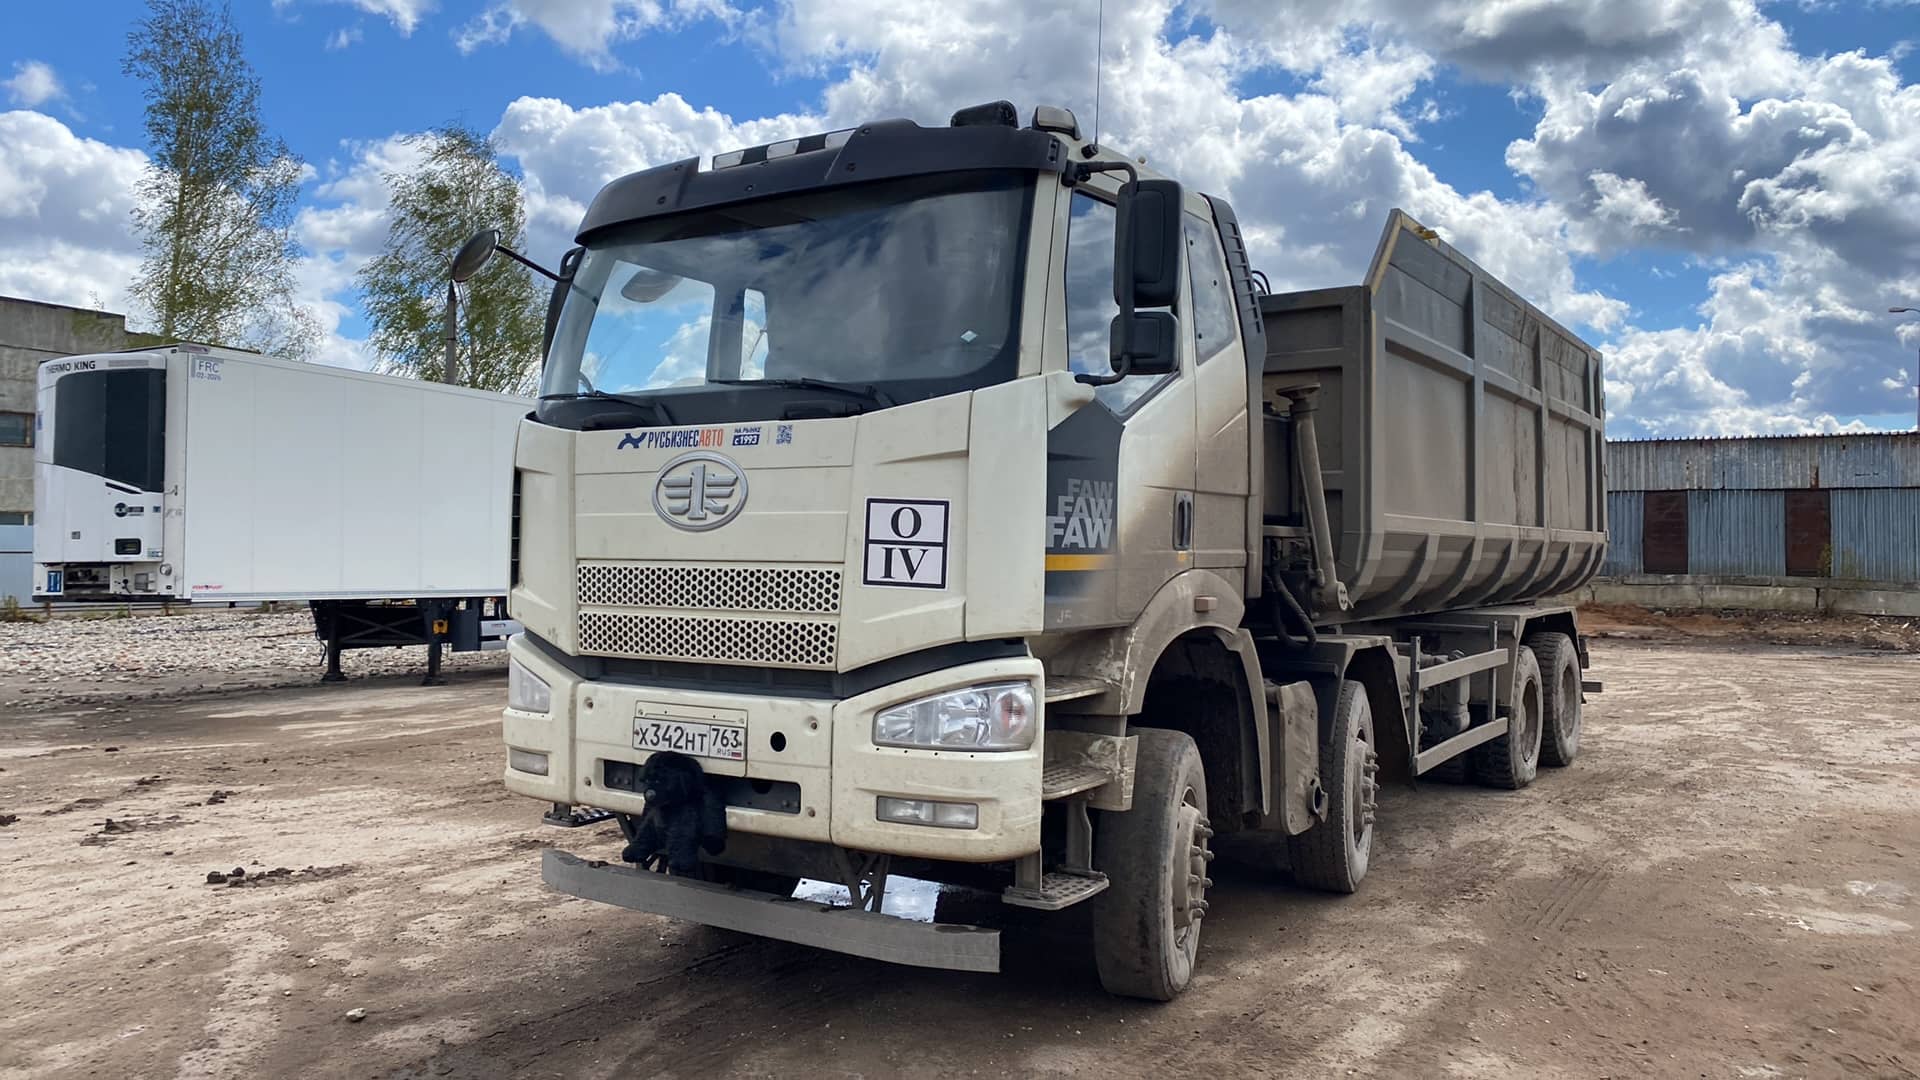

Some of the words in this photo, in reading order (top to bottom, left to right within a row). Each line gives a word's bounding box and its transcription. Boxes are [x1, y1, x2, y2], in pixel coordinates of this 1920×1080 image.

[74, 360, 96, 370] KING
[199, 360, 219, 373] FRC
[648, 428, 724, 448] РУСБИЗНЕСАВТО
[1068, 478, 1114, 500] FAW
[1057, 495, 1113, 521] FAW
[1045, 515, 1113, 548] FAW
[880, 546, 929, 581] IV
[711, 727, 740, 748] 763
[717, 748, 731, 757] RUS
